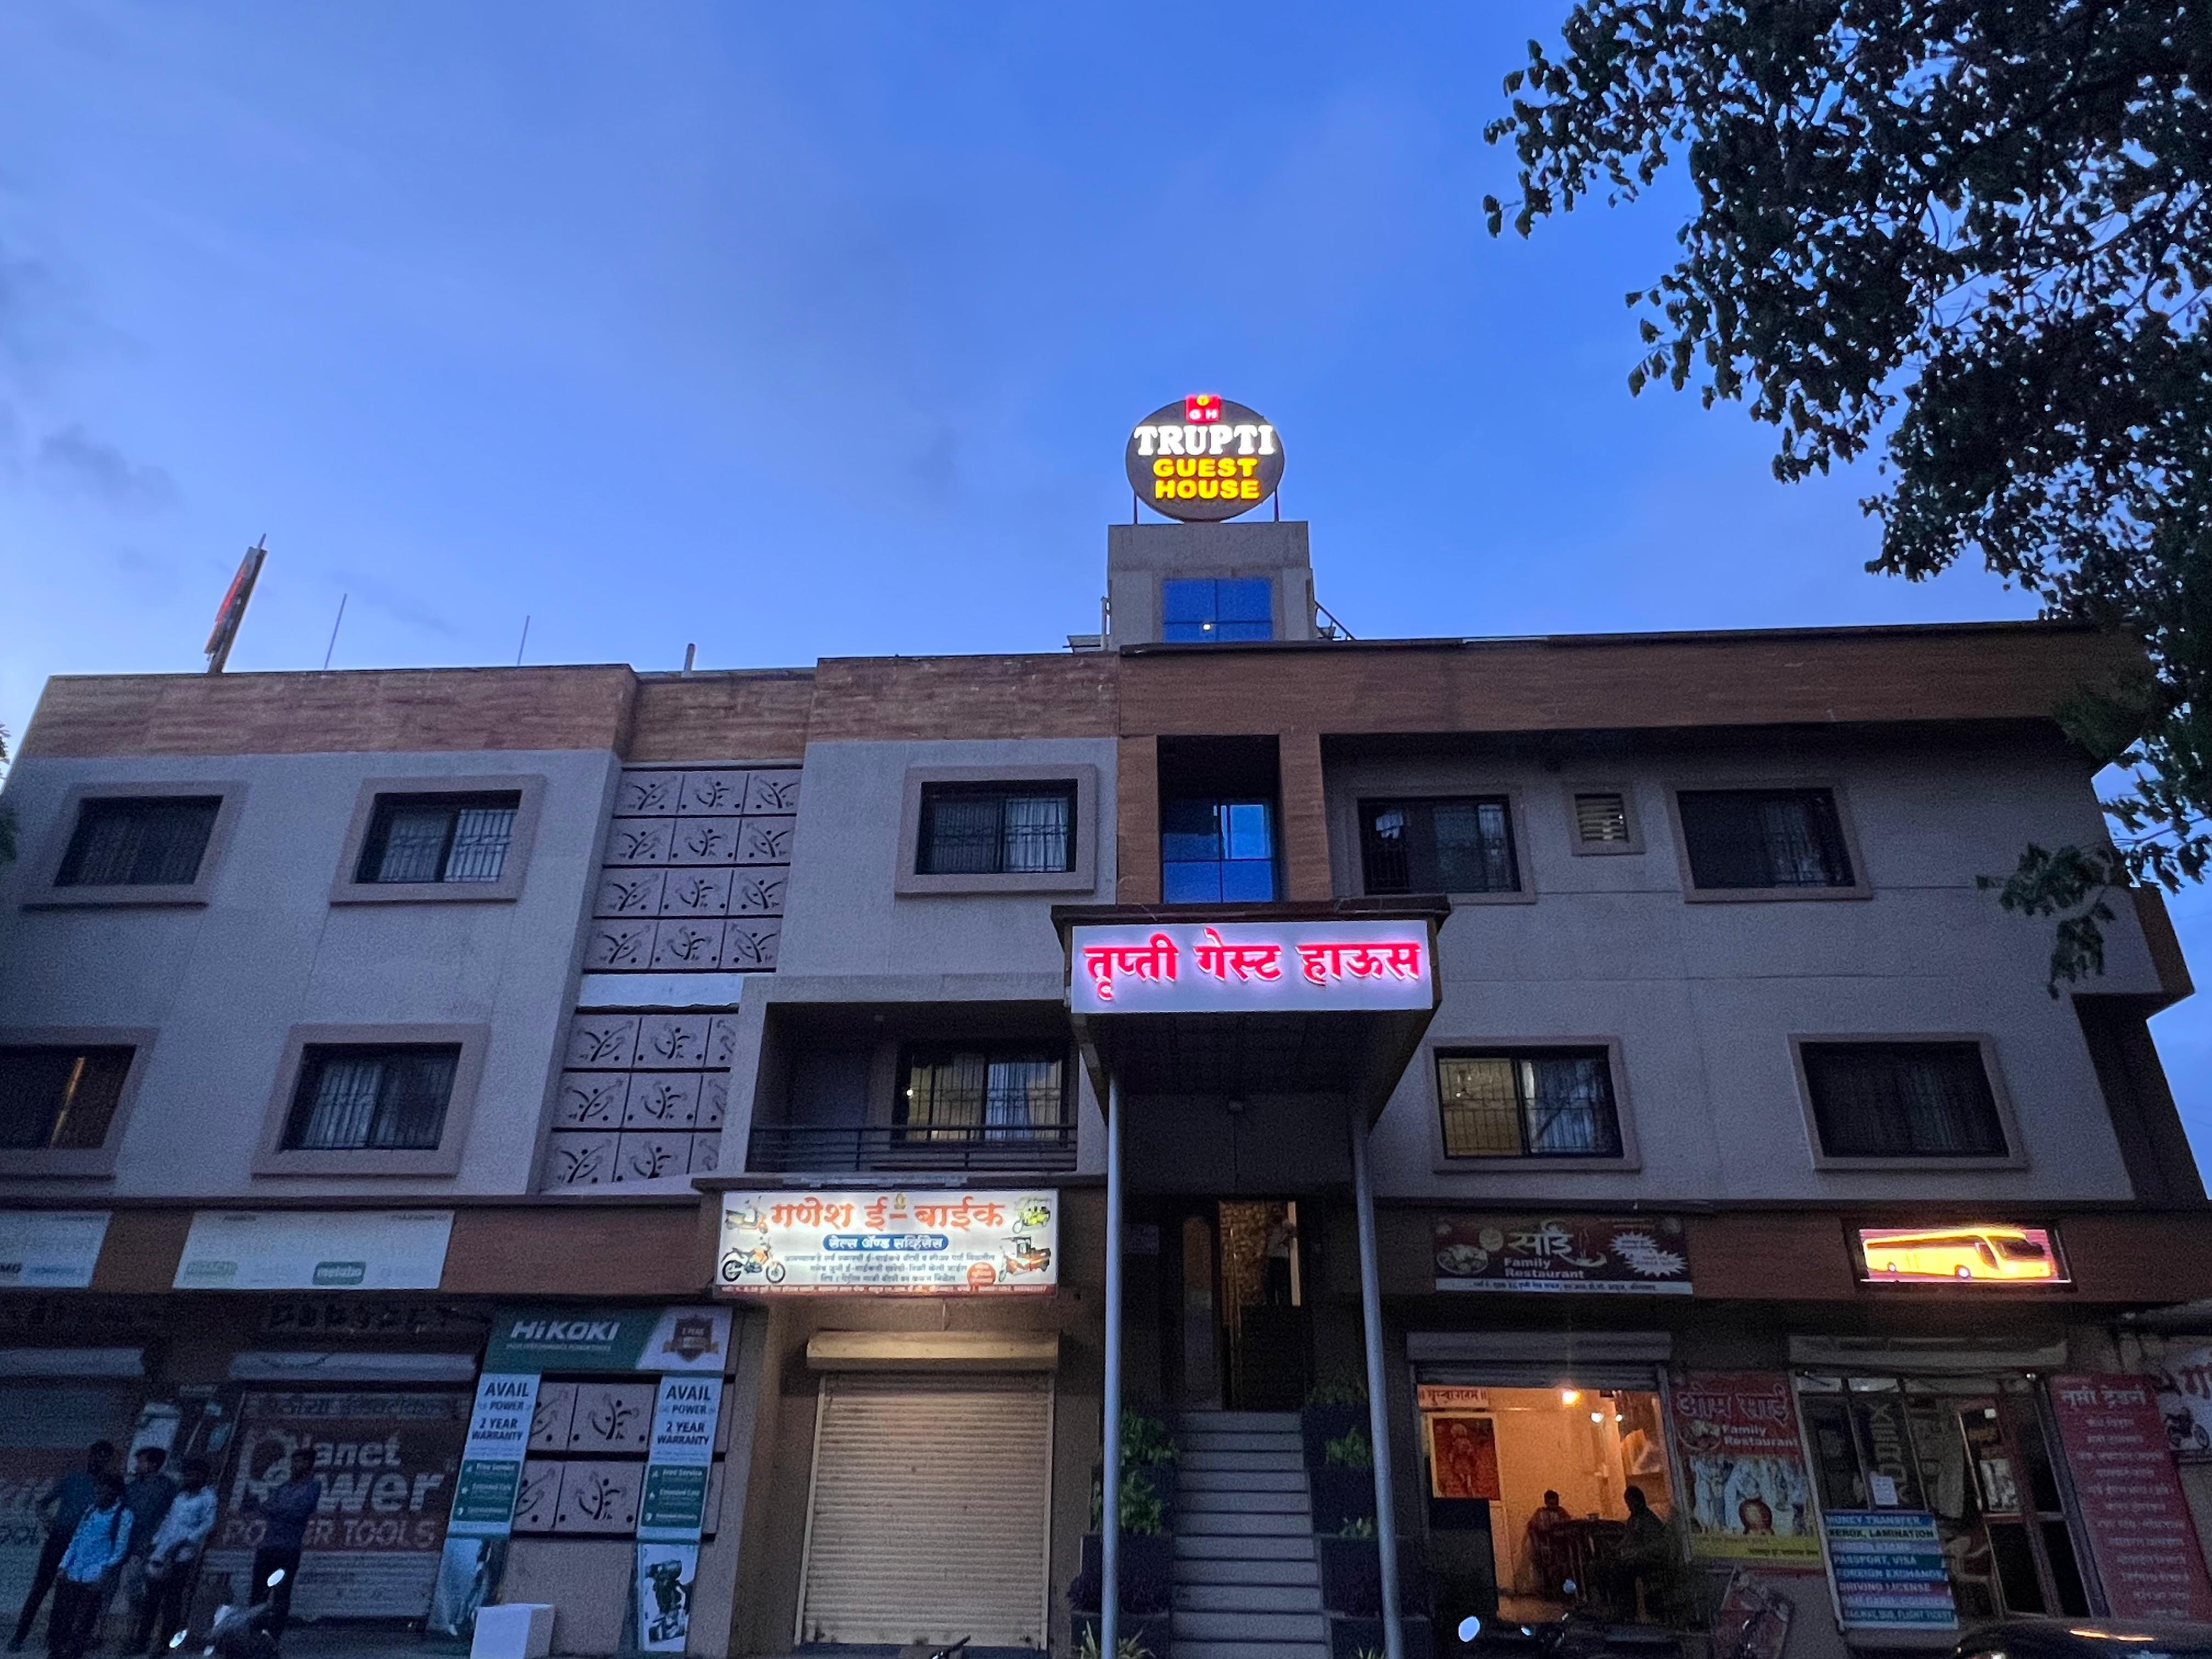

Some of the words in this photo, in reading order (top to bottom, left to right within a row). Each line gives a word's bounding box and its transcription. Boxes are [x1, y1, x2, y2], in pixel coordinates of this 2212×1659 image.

[1133, 425, 1276, 456] TRUPTI
[1153, 458, 1258, 478] GUEST
[1154, 479, 1260, 500] HOUSE
[1083, 932, 1179, 1001] तृप्ती
[1193, 927, 1282, 981] गेस्ट
[1296, 941, 1421, 986] हाऊस
[771, 1196, 854, 1230] गणेश
[1504, 1257, 1551, 1269] Family
[1505, 1268, 1584, 1279] Restaurant
[510, 1321, 621, 1341] HiKOKI
[485, 1382, 529, 1397] AVAIL
[665, 1385, 711, 1401] AVAIL
[490, 1401, 524, 1410] POWER
[672, 1404, 707, 1414] POWER
[490, 1418, 518, 1429] YEAR
[666, 1421, 673, 1433] 2
[676, 1422, 705, 1433] YEAR
[472, 1430, 523, 1440] WARRANTY
[1722, 1425, 1767, 1437] Family
[657, 1435, 710, 1445] WARRANTY
[1724, 1436, 1800, 1447] Restaurant
[1865, 1516, 1921, 1525] TRANSFER
[344, 1520, 436, 1548] TOOLS
[1869, 1528, 1934, 1538] LAMINATION
[1892, 1556, 1917, 1565] VISA
[1839, 1582, 1883, 1591] DRIVING
